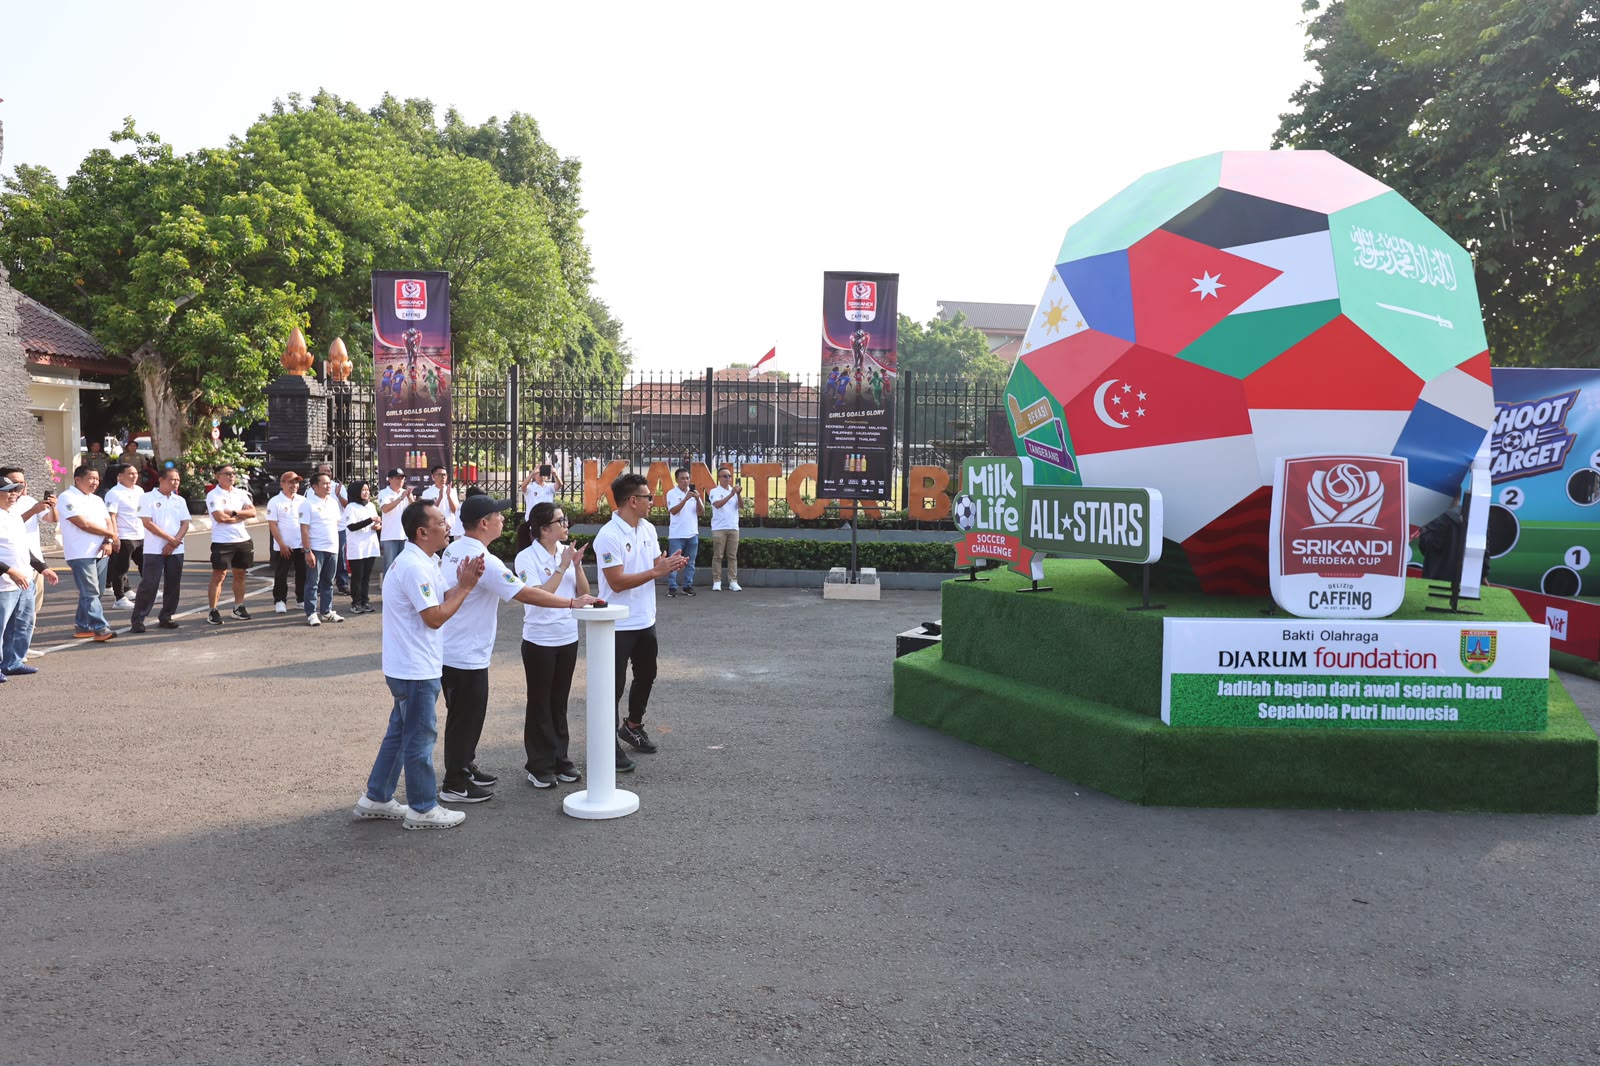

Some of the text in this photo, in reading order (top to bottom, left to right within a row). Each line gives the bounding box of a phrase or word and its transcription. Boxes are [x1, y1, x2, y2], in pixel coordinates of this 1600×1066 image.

[423, 406, 442, 414] GLORY
[1027, 405, 1049, 425] BEKASI
[1028, 443, 1060, 463] TANGERANG
[968, 463, 1017, 498] Milk
[1505, 490, 1518, 505] 2
[976, 497, 1019, 532] Life
[976, 533, 1006, 546] SOCCER
[1292, 539, 1393, 556] SRIKANDI
[971, 544, 1012, 558] CHALLENGE
[1571, 549, 1582, 565] 1
[1302, 556, 1381, 565] MERDEKA CUP
[1309, 591, 1372, 610] CAFFINO
[1547, 615, 1566, 633] Vit
[1282, 630, 1379, 644] Bakti Olahraga
[1218, 647, 1437, 669] DJARUM foundation
[1217, 680, 1503, 700] Jadilah bagian dari awal sejarah baru
[1258, 702, 1459, 721] Sepakbola Putri Indonesia
